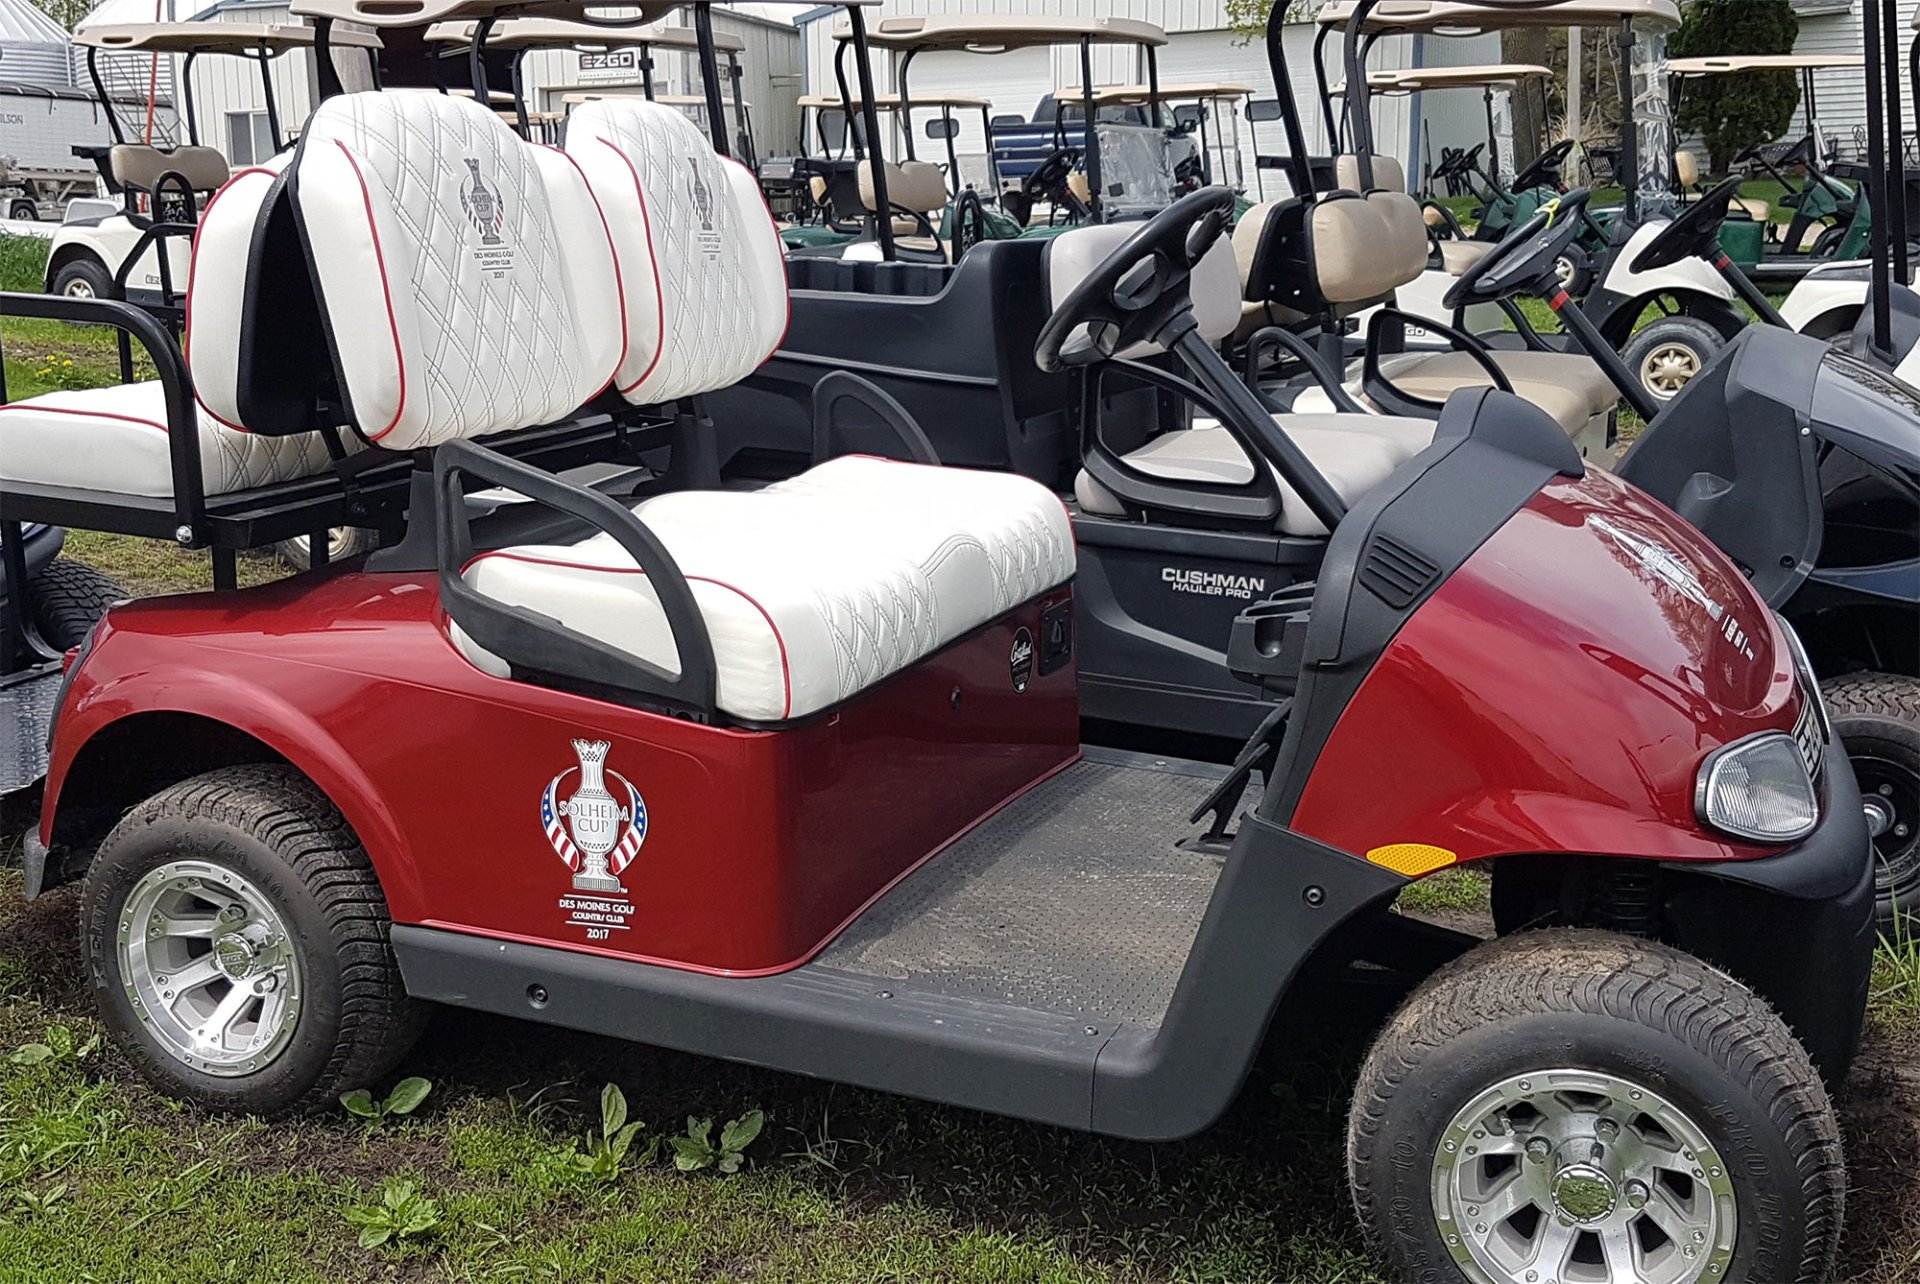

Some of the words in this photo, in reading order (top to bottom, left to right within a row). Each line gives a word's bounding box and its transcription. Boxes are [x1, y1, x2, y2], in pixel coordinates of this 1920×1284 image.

[0, 113, 24, 125] ILSON
[1405, 326, 1425, 337] GO
[1162, 567, 1265, 592] CUSHMAN
[1172, 582, 1223, 596] HAULER
[1225, 588, 1251, 599] PRO
[559, 801, 630, 822] SOLHEIM
[578, 818, 609, 833] CUP
[559, 899, 575, 909] DES
[576, 901, 611, 912] MOINES
[612, 904, 635, 914] GOLF
[572, 911, 605, 921] COUNTRY
[605, 914, 625, 923] CLUB
[587, 928, 609, 939] 2017
